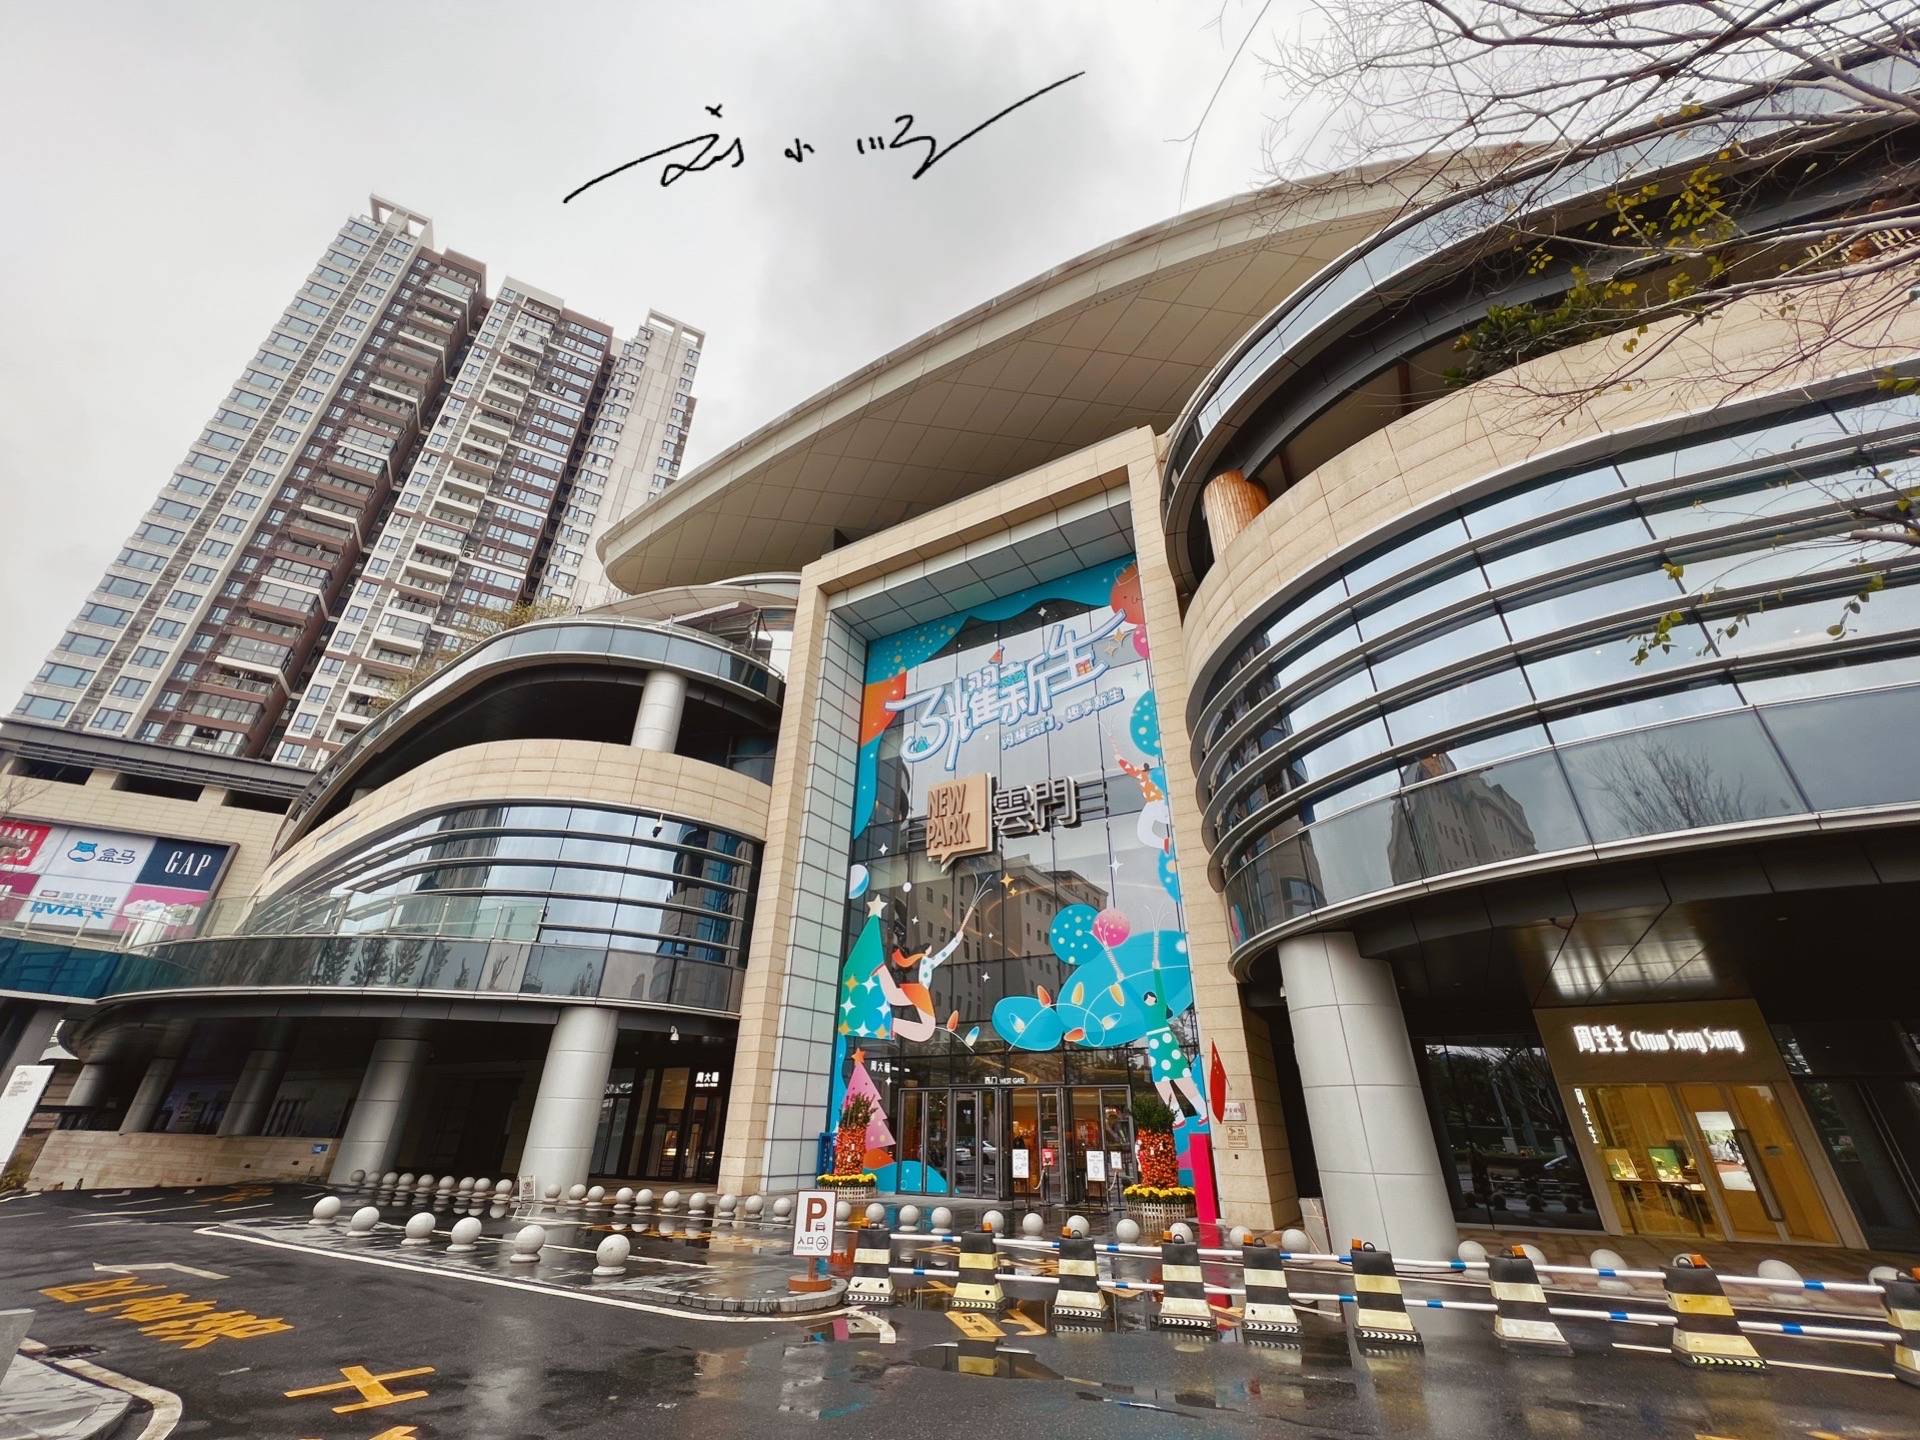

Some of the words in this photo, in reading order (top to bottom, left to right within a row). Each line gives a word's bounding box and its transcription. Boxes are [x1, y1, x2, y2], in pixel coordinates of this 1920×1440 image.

[928, 783, 967, 819] NEW
[992, 776, 1077, 836] 雲門
[926, 813, 971, 849] PARK
[97, 848, 137, 865] 盒马
[164, 850, 213, 877] GAP
[1573, 1025, 1629, 1053] 周生生
[1667, 1028, 1708, 1054] Sang
[1702, 1027, 1746, 1054] Sang
[805, 1197, 828, 1233] P
[797, 1235, 814, 1245] 入口
